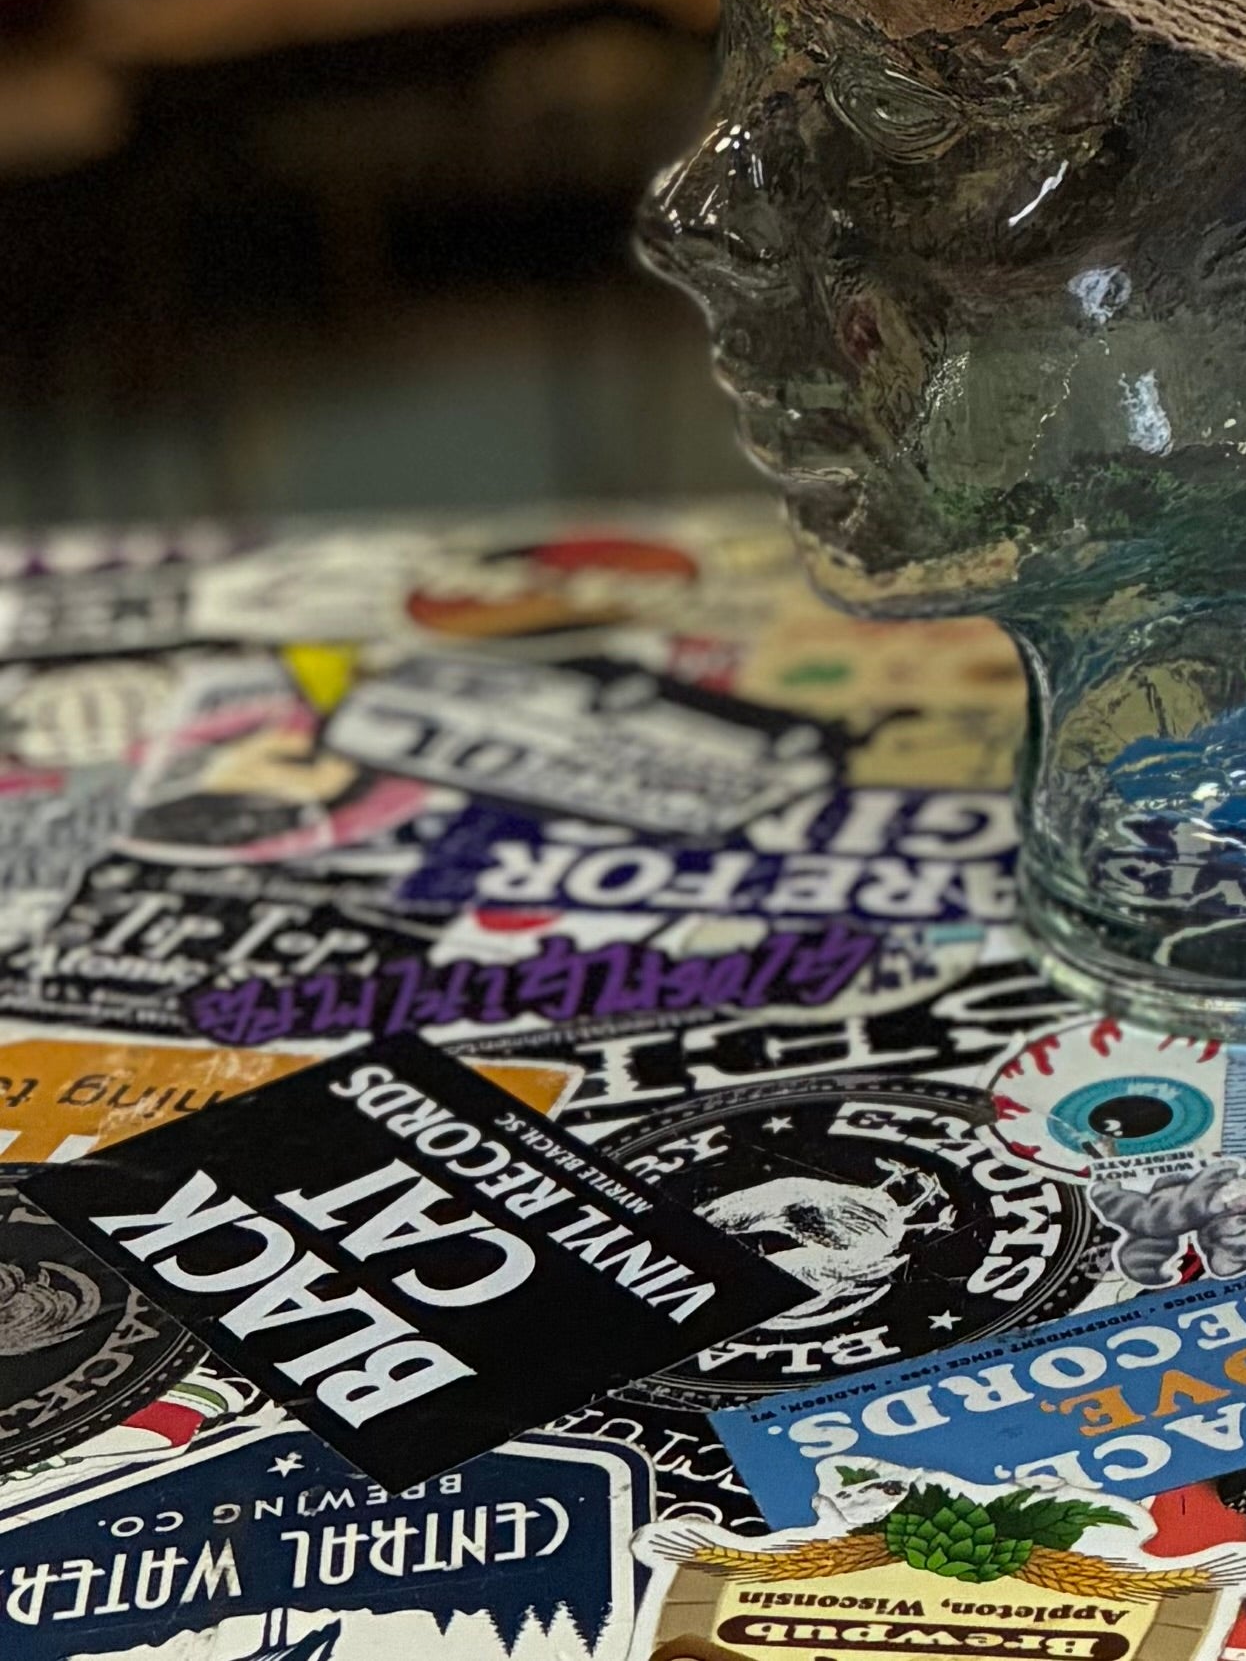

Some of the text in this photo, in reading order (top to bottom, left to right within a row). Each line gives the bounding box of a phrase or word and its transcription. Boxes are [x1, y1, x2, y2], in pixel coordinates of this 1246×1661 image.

[475, 846, 754, 908] FOR
[494, 1112, 524, 1132] SC
[329, 1065, 571, 1223] RECORDS
[1093, 1151, 1194, 1170] HESITATE
[1094, 1170, 1136, 1182] NOT
[1143, 1163, 1193, 1176] WILL
[575, 1165, 654, 1215] MYRTLE
[274, 1158, 536, 1308] CAT
[548, 1205, 716, 1323] VINYL
[90, 1170, 477, 1430] BLACK
[1162, 1289, 1217, 1312] DISCS
[998, 1312, 1143, 1356] INDEPENDENT
[945, 1351, 993, 1371] SINCE
[776, 1381, 876, 1414] MADISON,
[752, 1412, 772, 1423] WI
[97, 1510, 184, 1536] CO.
[280, 1498, 569, 1588] CENTRAL
[737, 1591, 1130, 1626] Appleton, Wisconsin
[742, 1620, 1101, 1659] Brewpub
